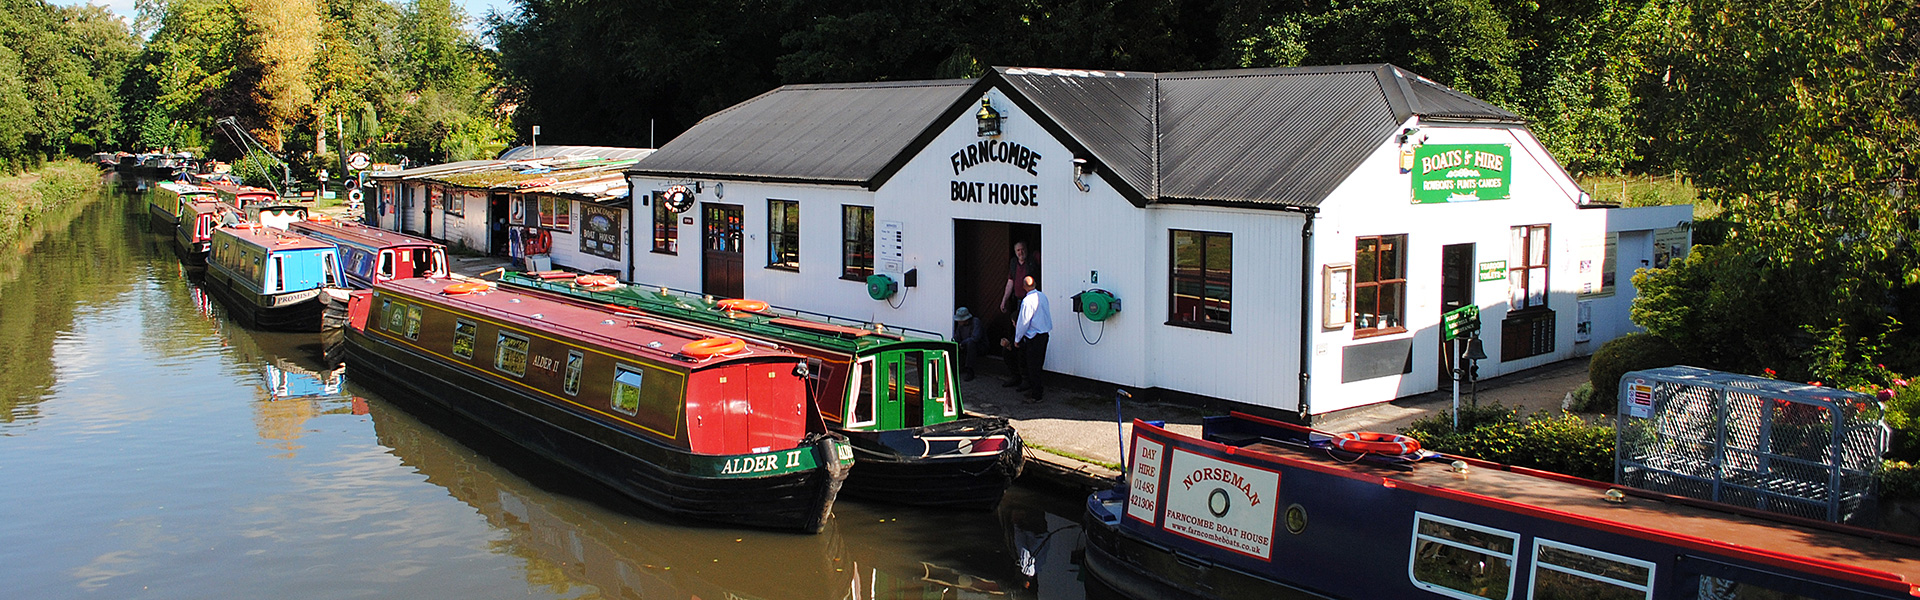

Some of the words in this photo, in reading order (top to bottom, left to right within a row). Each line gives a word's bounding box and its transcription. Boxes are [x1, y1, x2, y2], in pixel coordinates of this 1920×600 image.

[950, 139, 1042, 177] FARNCOMBE
[1421, 149, 1462, 175] BOATS
[1464, 150, 1473, 165] &
[1474, 150, 1504, 172] HIRE
[1457, 179, 1477, 189] PUNTS
[1478, 177, 1502, 188] CANOES
[950, 180, 984, 203] BOAT
[988, 183, 1039, 206] HOUSE
[587, 206, 615, 222] FARNCOMBE
[583, 229, 596, 239] BOAT
[598, 233, 616, 244] HOUSE
[532, 354, 552, 371] ALDER
[553, 360, 560, 372] II
[721, 453, 779, 475] ALDER
[785, 450, 801, 468] II
[1141, 447, 1157, 460] DAY
[1138, 463, 1156, 478] HIRE
[1134, 478, 1155, 495] 01483
[1182, 467, 1261, 508] NORSEMAN
[1130, 494, 1155, 512] 421306
[1166, 509, 1215, 530] FARNCOMBE
[1216, 521, 1239, 537] BOAT
[1240, 530, 1269, 546] HOUSE
[1171, 522, 1261, 554] www.farncombeboats.co.uk
